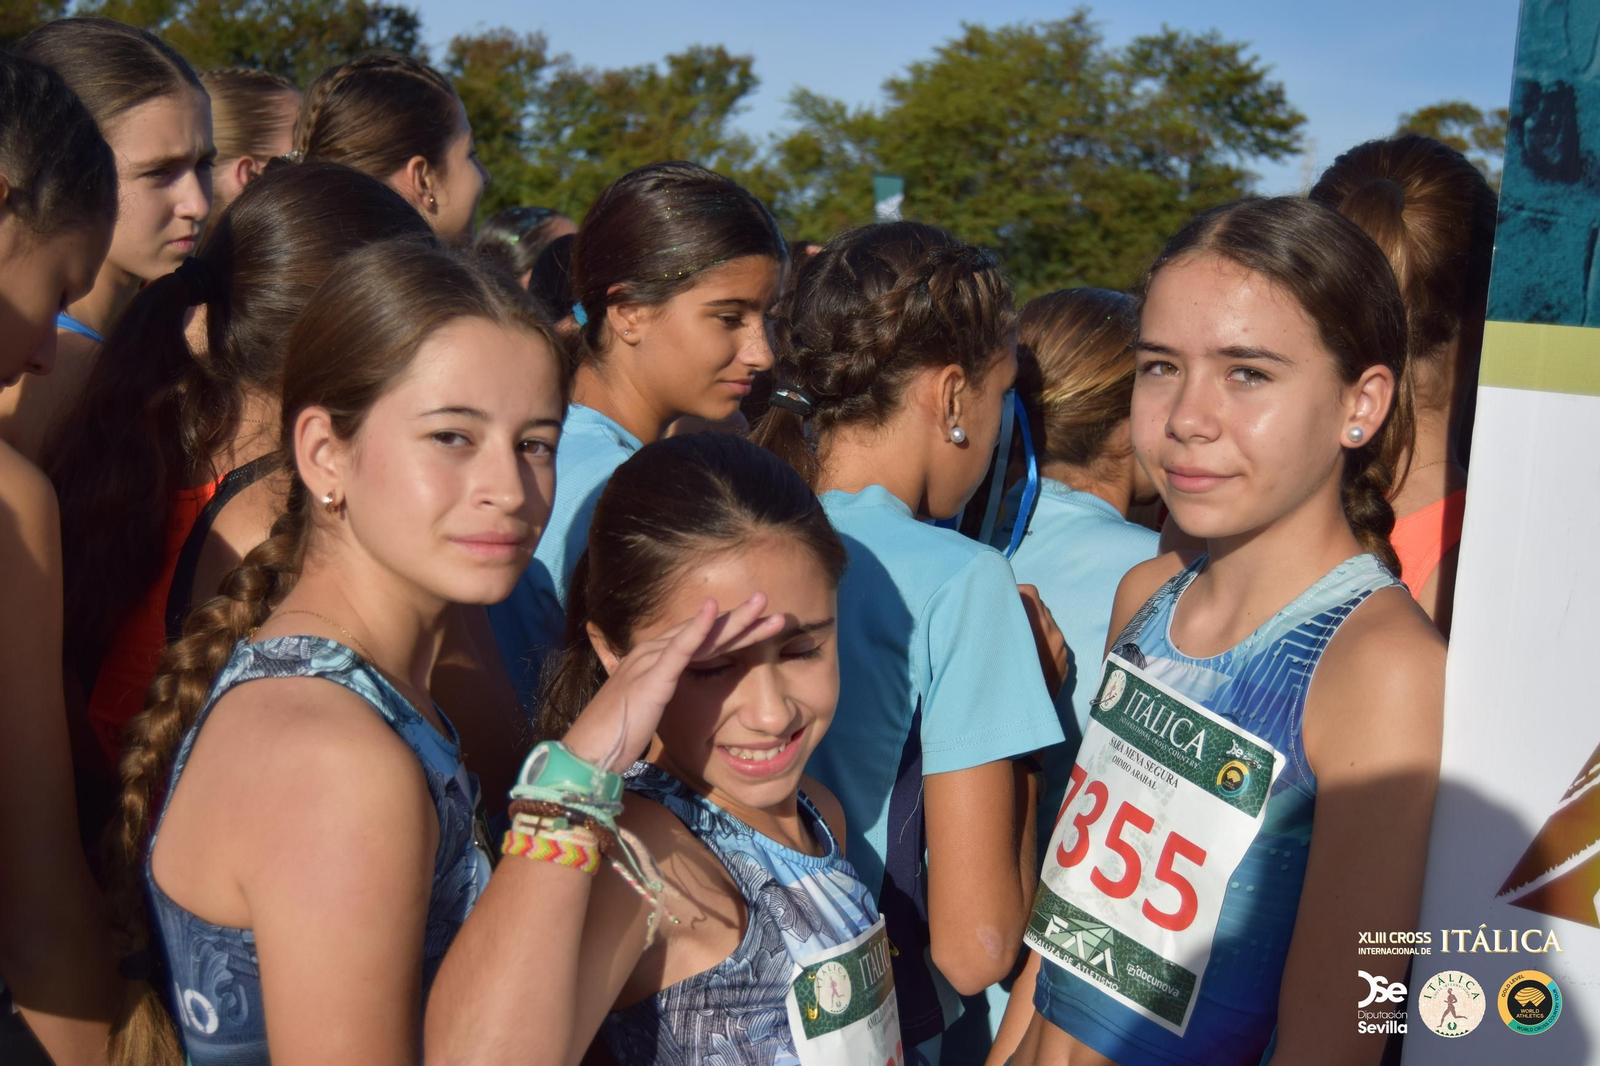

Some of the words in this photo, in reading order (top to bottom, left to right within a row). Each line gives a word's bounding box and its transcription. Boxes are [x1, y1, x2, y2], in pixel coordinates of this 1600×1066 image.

[1123, 688, 1206, 761] ITÁLICA
[1108, 736, 1124, 754] SARA
[1124, 746, 1145, 767] MENA
[1144, 760, 1179, 789] SEGURA
[1111, 755, 1132, 772] OHMIO
[1130, 768, 1157, 790] ARAHAL
[1168, 747, 1200, 769] COUNTRY
[859, 937, 891, 990] ITÁLIC
[1027, 931, 1060, 960] ANDALUZA
[1063, 954, 1073, 964] DE
[1075, 962, 1119, 991] ATLETISMO
[1136, 967, 1181, 998] docunova
